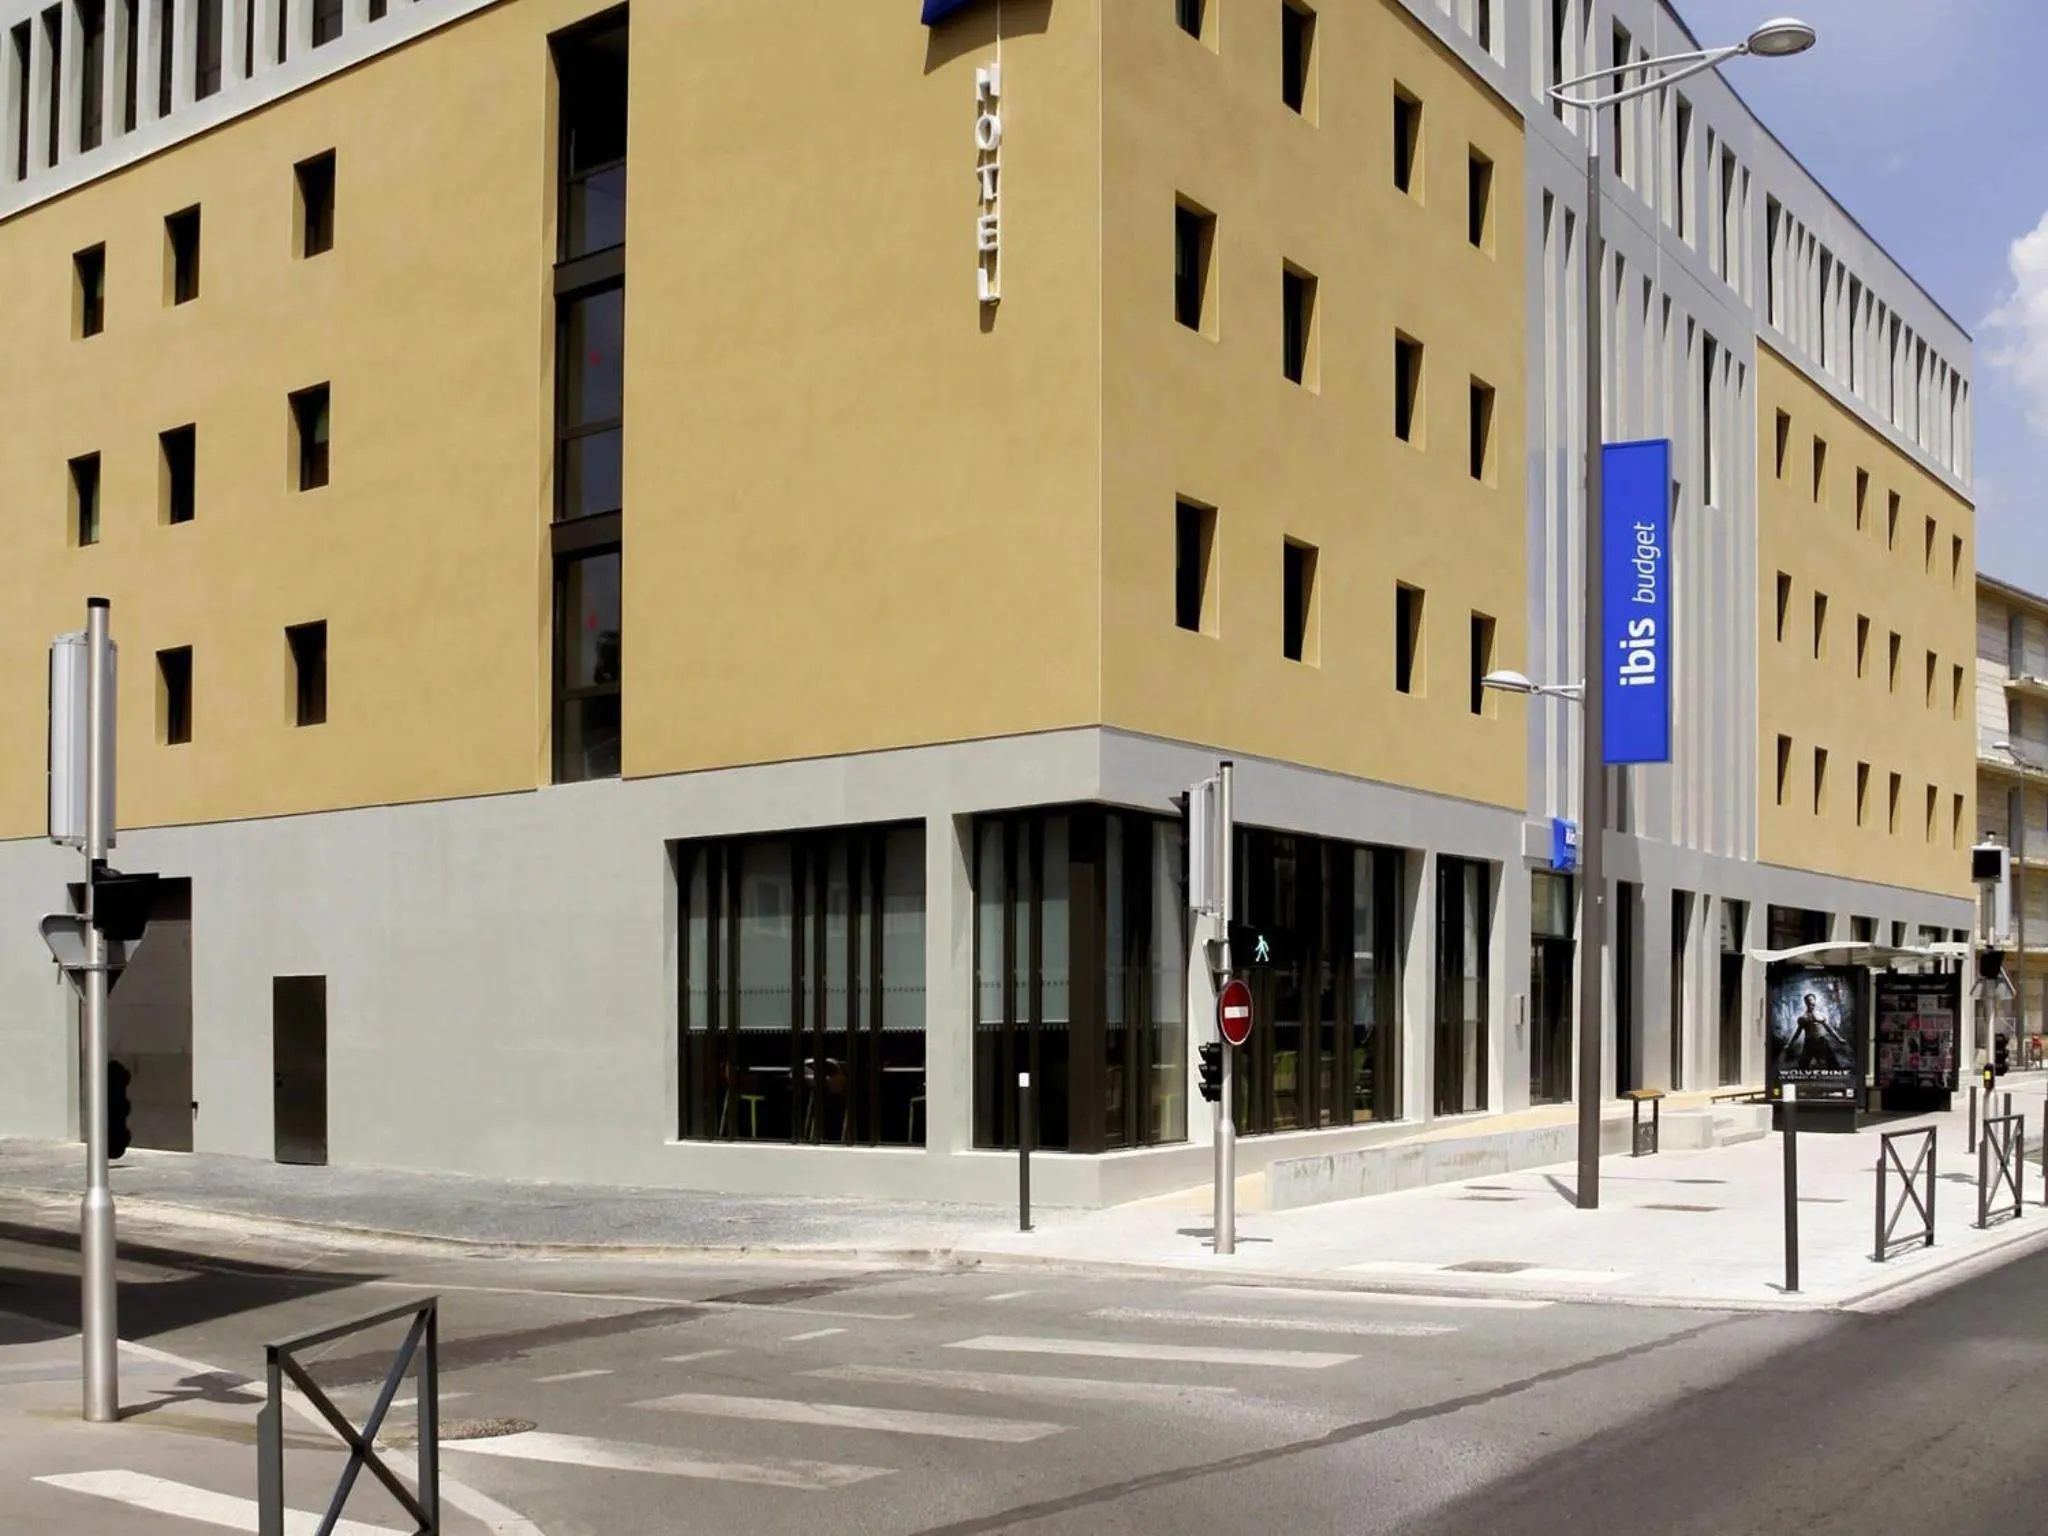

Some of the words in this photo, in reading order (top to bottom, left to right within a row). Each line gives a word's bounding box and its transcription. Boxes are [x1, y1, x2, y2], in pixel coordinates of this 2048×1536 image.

[975, 63, 1001, 303] HOTEL
[1632, 521, 1661, 604] budget
[1619, 618, 1656, 686] ibis
